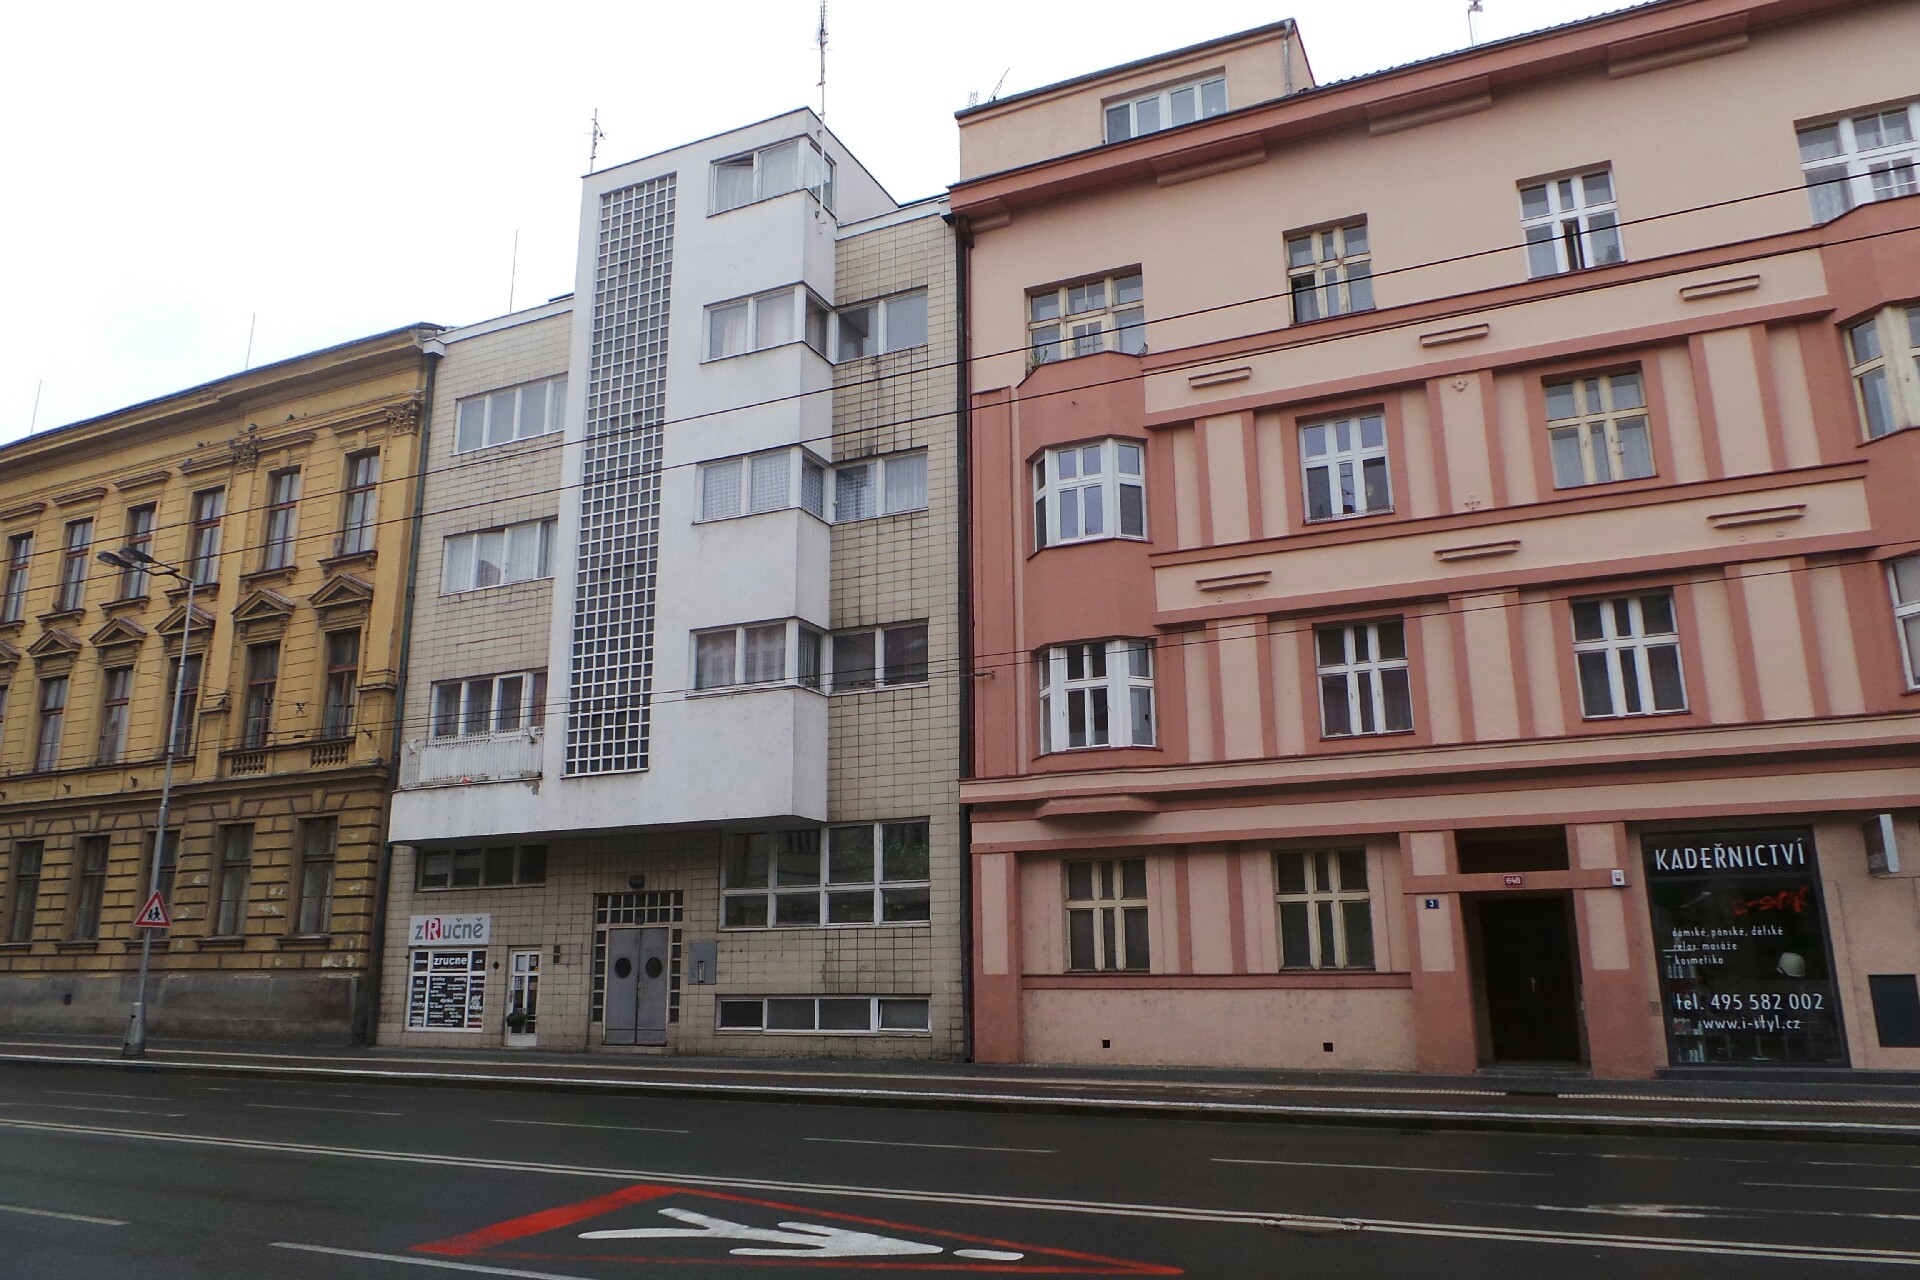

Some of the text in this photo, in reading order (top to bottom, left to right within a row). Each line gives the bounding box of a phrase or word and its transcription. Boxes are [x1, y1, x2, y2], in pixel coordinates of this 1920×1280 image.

[1655, 838, 1805, 870] KADEŘNICTVÍ
[1675, 955, 1724, 966] kosmetika
[1675, 993, 1824, 1011] tel. 495 582 002
[1703, 1014, 1802, 1032] www.i-styl.cz
